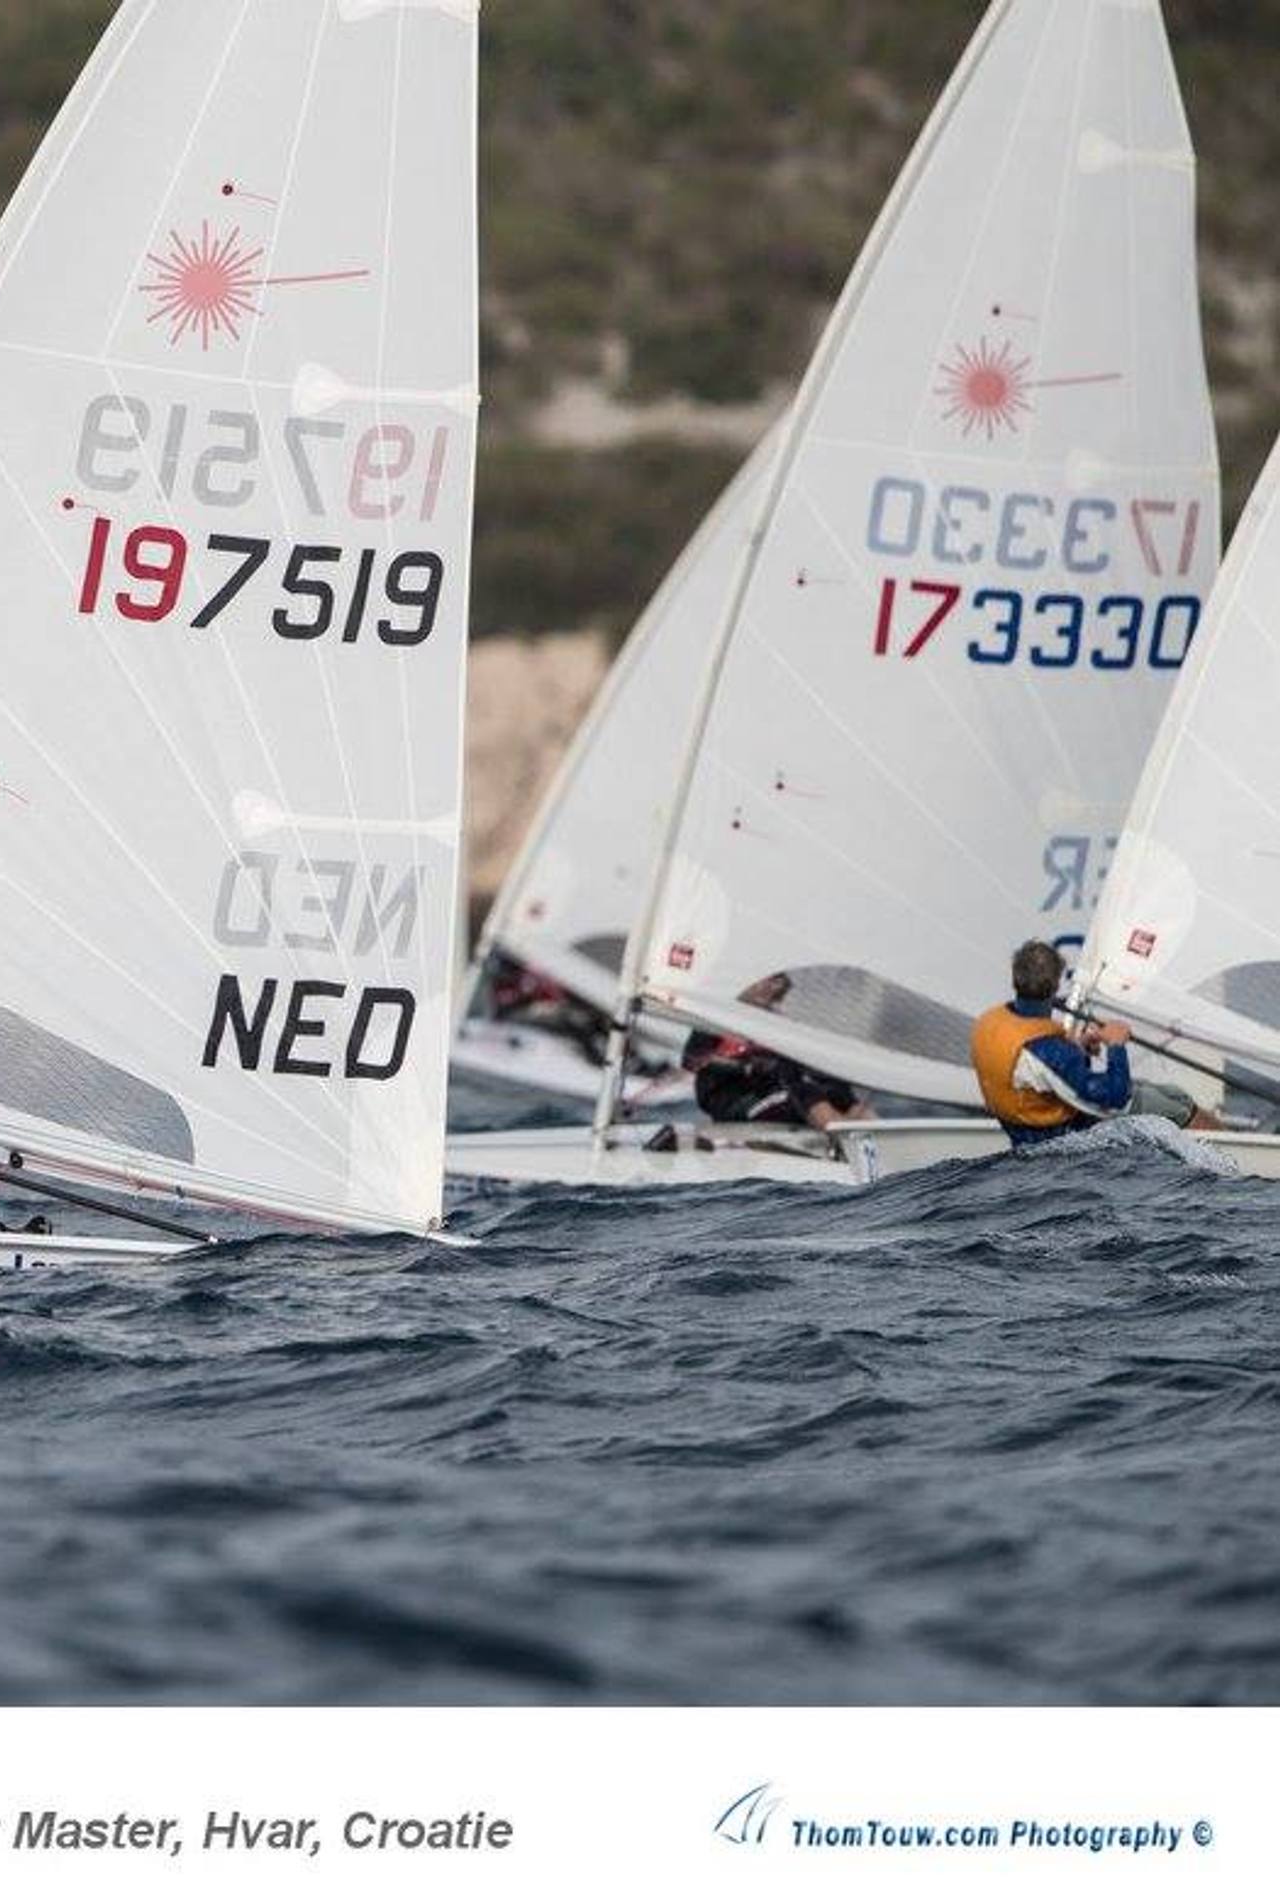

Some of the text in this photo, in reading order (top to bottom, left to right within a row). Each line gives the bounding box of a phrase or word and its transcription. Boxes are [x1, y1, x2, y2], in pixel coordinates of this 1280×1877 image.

[78, 517, 444, 647] 197519
[873, 578, 1201, 669] 173330
[202, 973, 416, 1081] NED
